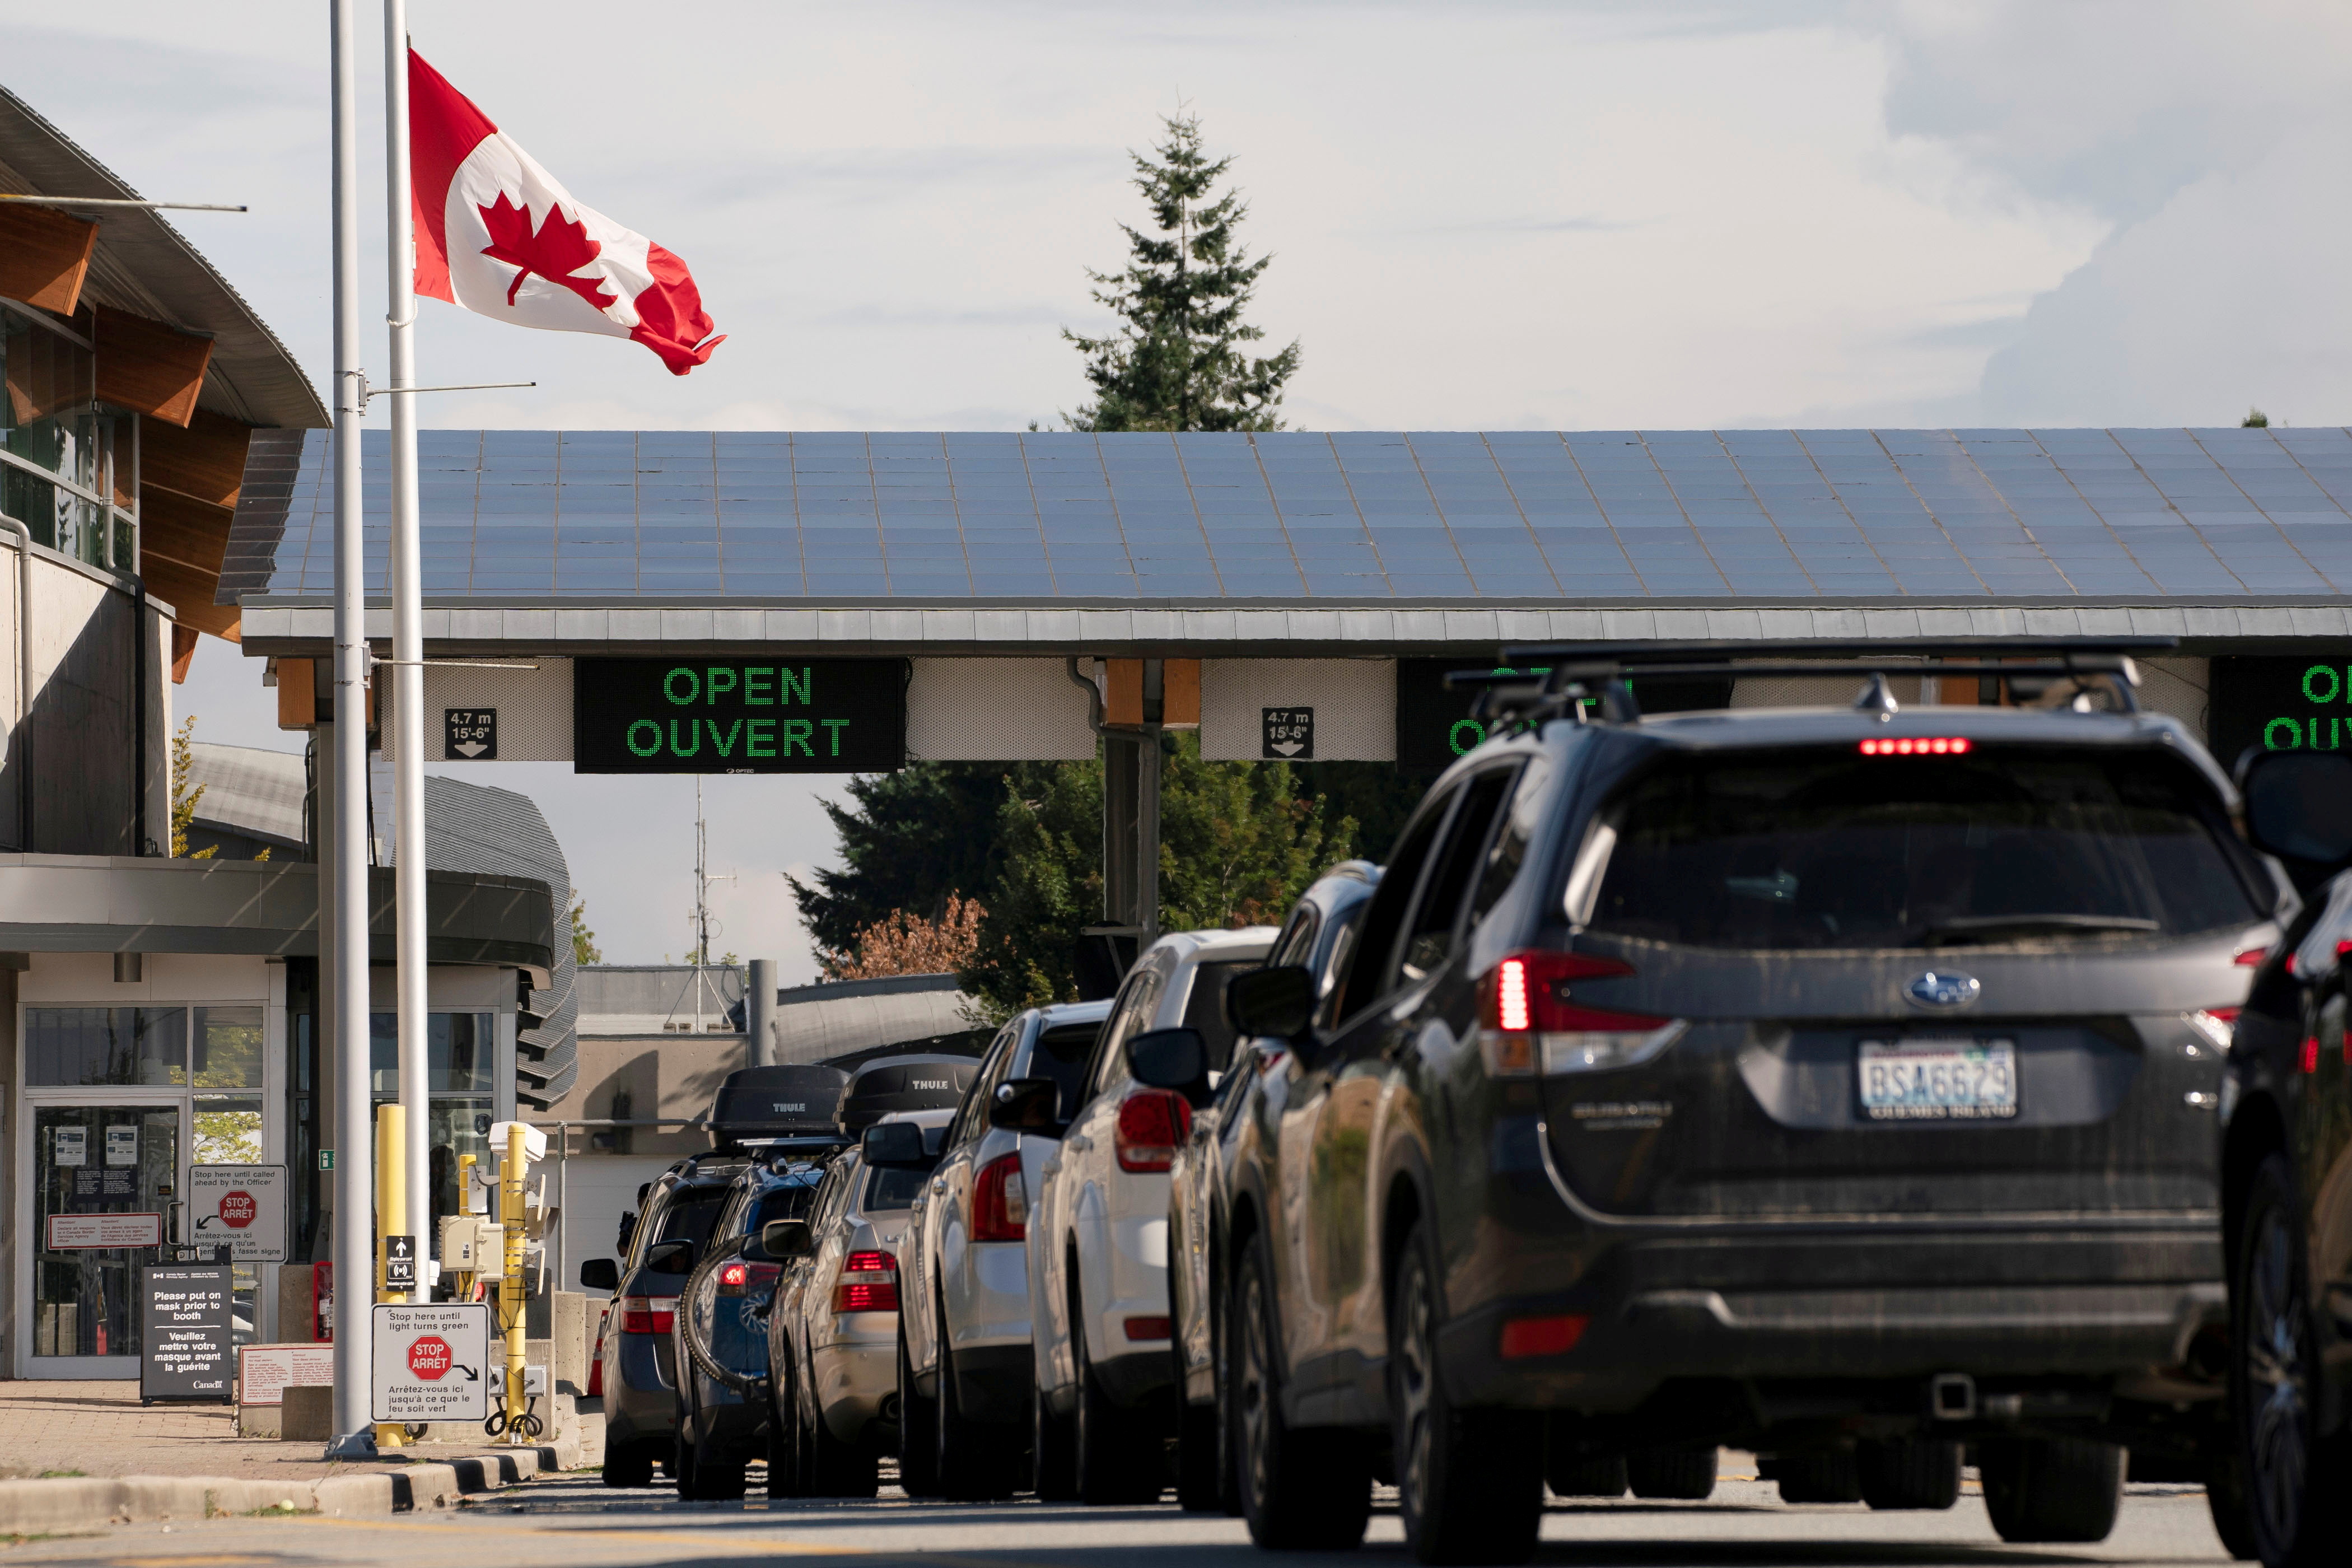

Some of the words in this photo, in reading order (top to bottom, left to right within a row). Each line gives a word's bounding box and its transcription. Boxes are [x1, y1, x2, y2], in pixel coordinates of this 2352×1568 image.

[664, 668, 811, 705] OPEN
[2303, 665, 2352, 703] O
[451, 713, 472, 724] 4.7
[478, 715, 491, 724] m
[1268, 712, 1289, 722] 4.7
[1295, 714, 1309, 723] m
[452, 727, 489, 739] 15'-6"
[1269, 726, 1307, 739] 15'-6"
[2264, 717, 2352, 751] OU
[627, 719, 850, 757] OUVERT
[913, 1080, 948, 1090] THULE
[1869, 1064, 2012, 1104] BSA6629
[773, 1103, 805, 1112] THULE
[226, 1197, 250, 1207] STOP
[223, 1207, 253, 1218] ARRÊT
[154, 1292, 186, 1300] Please
[189, 1291, 206, 1301] put
[155, 1302, 181, 1310] mask
[184, 1302, 207, 1312] prior
[174, 1312, 201, 1320] booth
[389, 1313, 411, 1322] Stop
[389, 1323, 410, 1332] light
[442, 1323, 469, 1331] green
[169, 1332, 206, 1341] Veuillez
[159, 1342, 189, 1351] mettre
[416, 1344, 444, 1356] STOP
[155, 1354, 192, 1362] masque
[195, 1352, 221, 1361] avant
[412, 1355, 447, 1369] ARRÊT
[165, 1362, 173, 1371] la
[177, 1362, 211, 1373] guérite
[193, 1380, 223, 1389] Canada
[389, 1385, 448, 1393] Arrêtez-vous
[389, 1396, 422, 1404] jusqu'à
